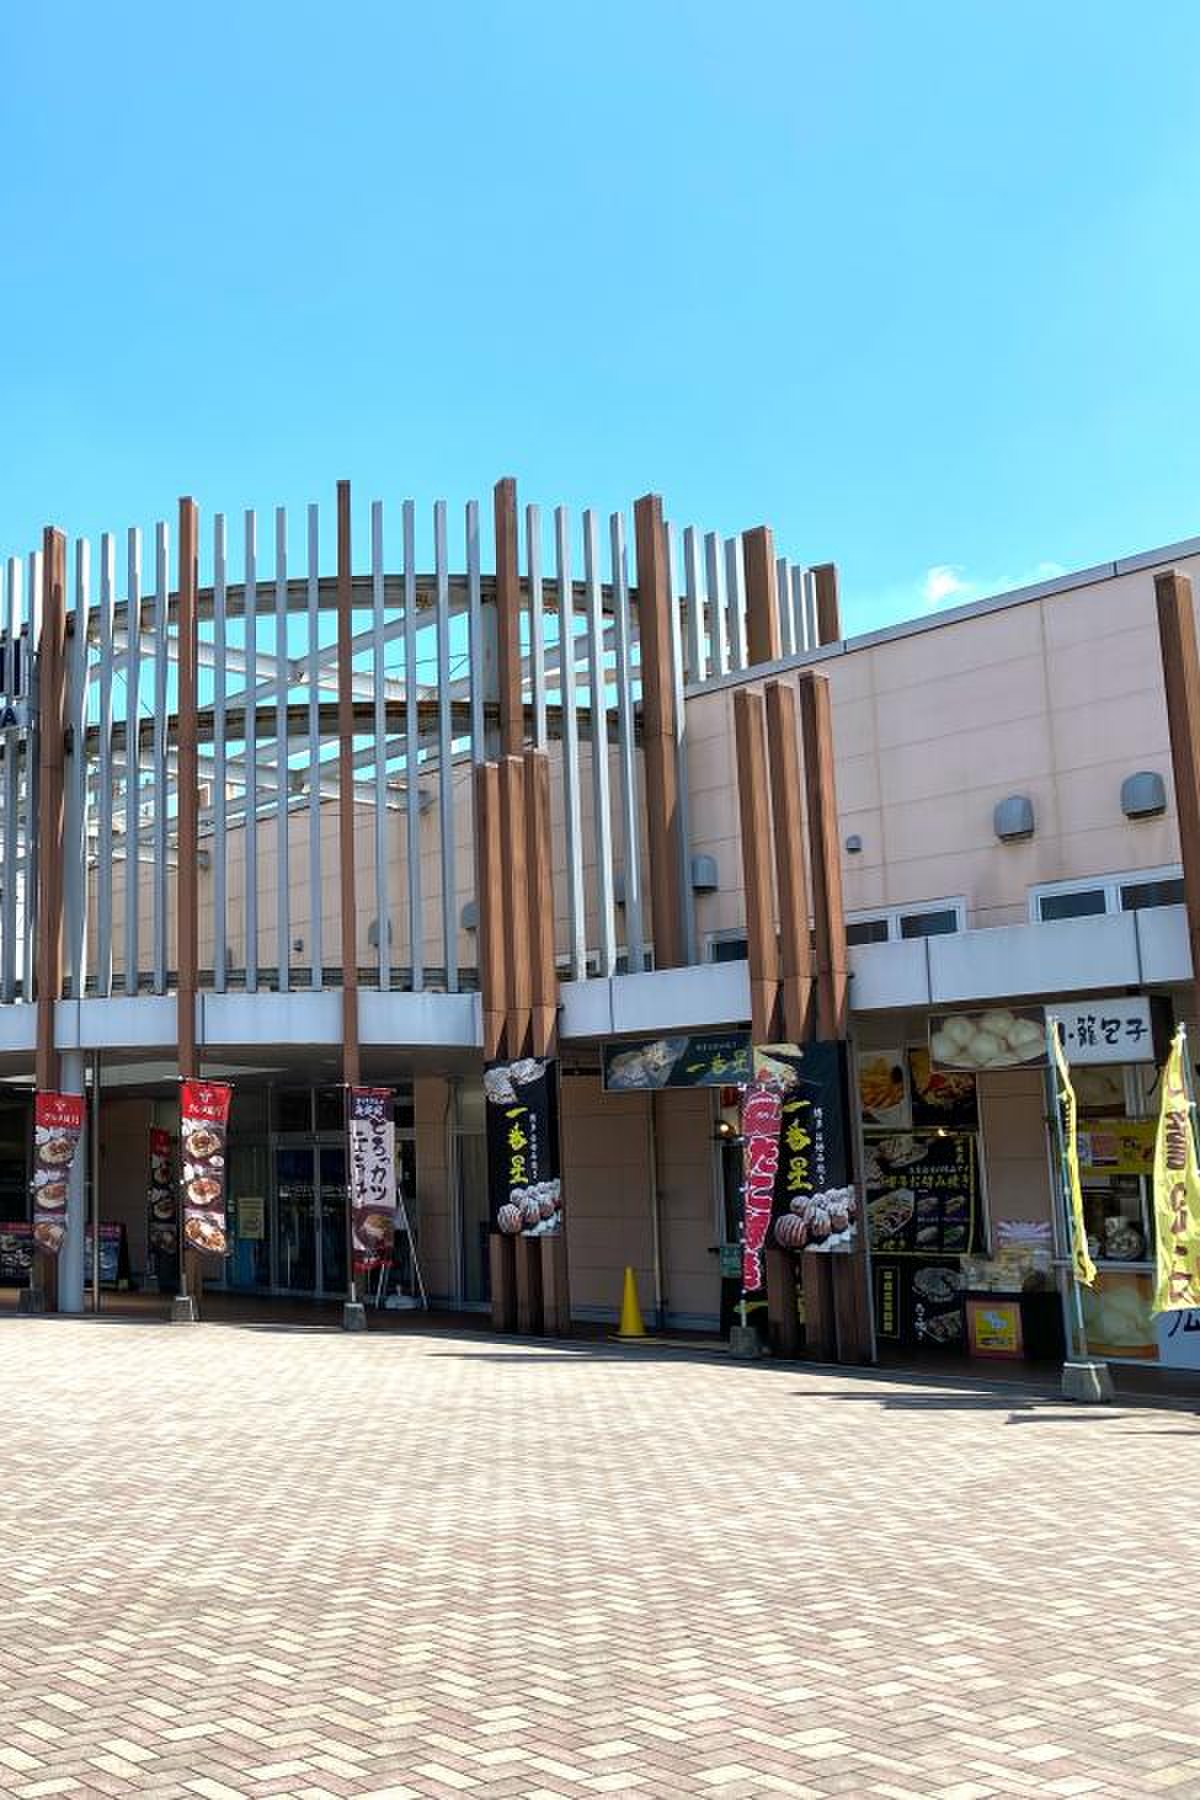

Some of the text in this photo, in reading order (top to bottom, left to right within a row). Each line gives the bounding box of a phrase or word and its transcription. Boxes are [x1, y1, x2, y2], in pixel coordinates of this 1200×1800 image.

[504, 1106, 529, 1185] 一番星
[783, 1100, 814, 1192] 一番星
